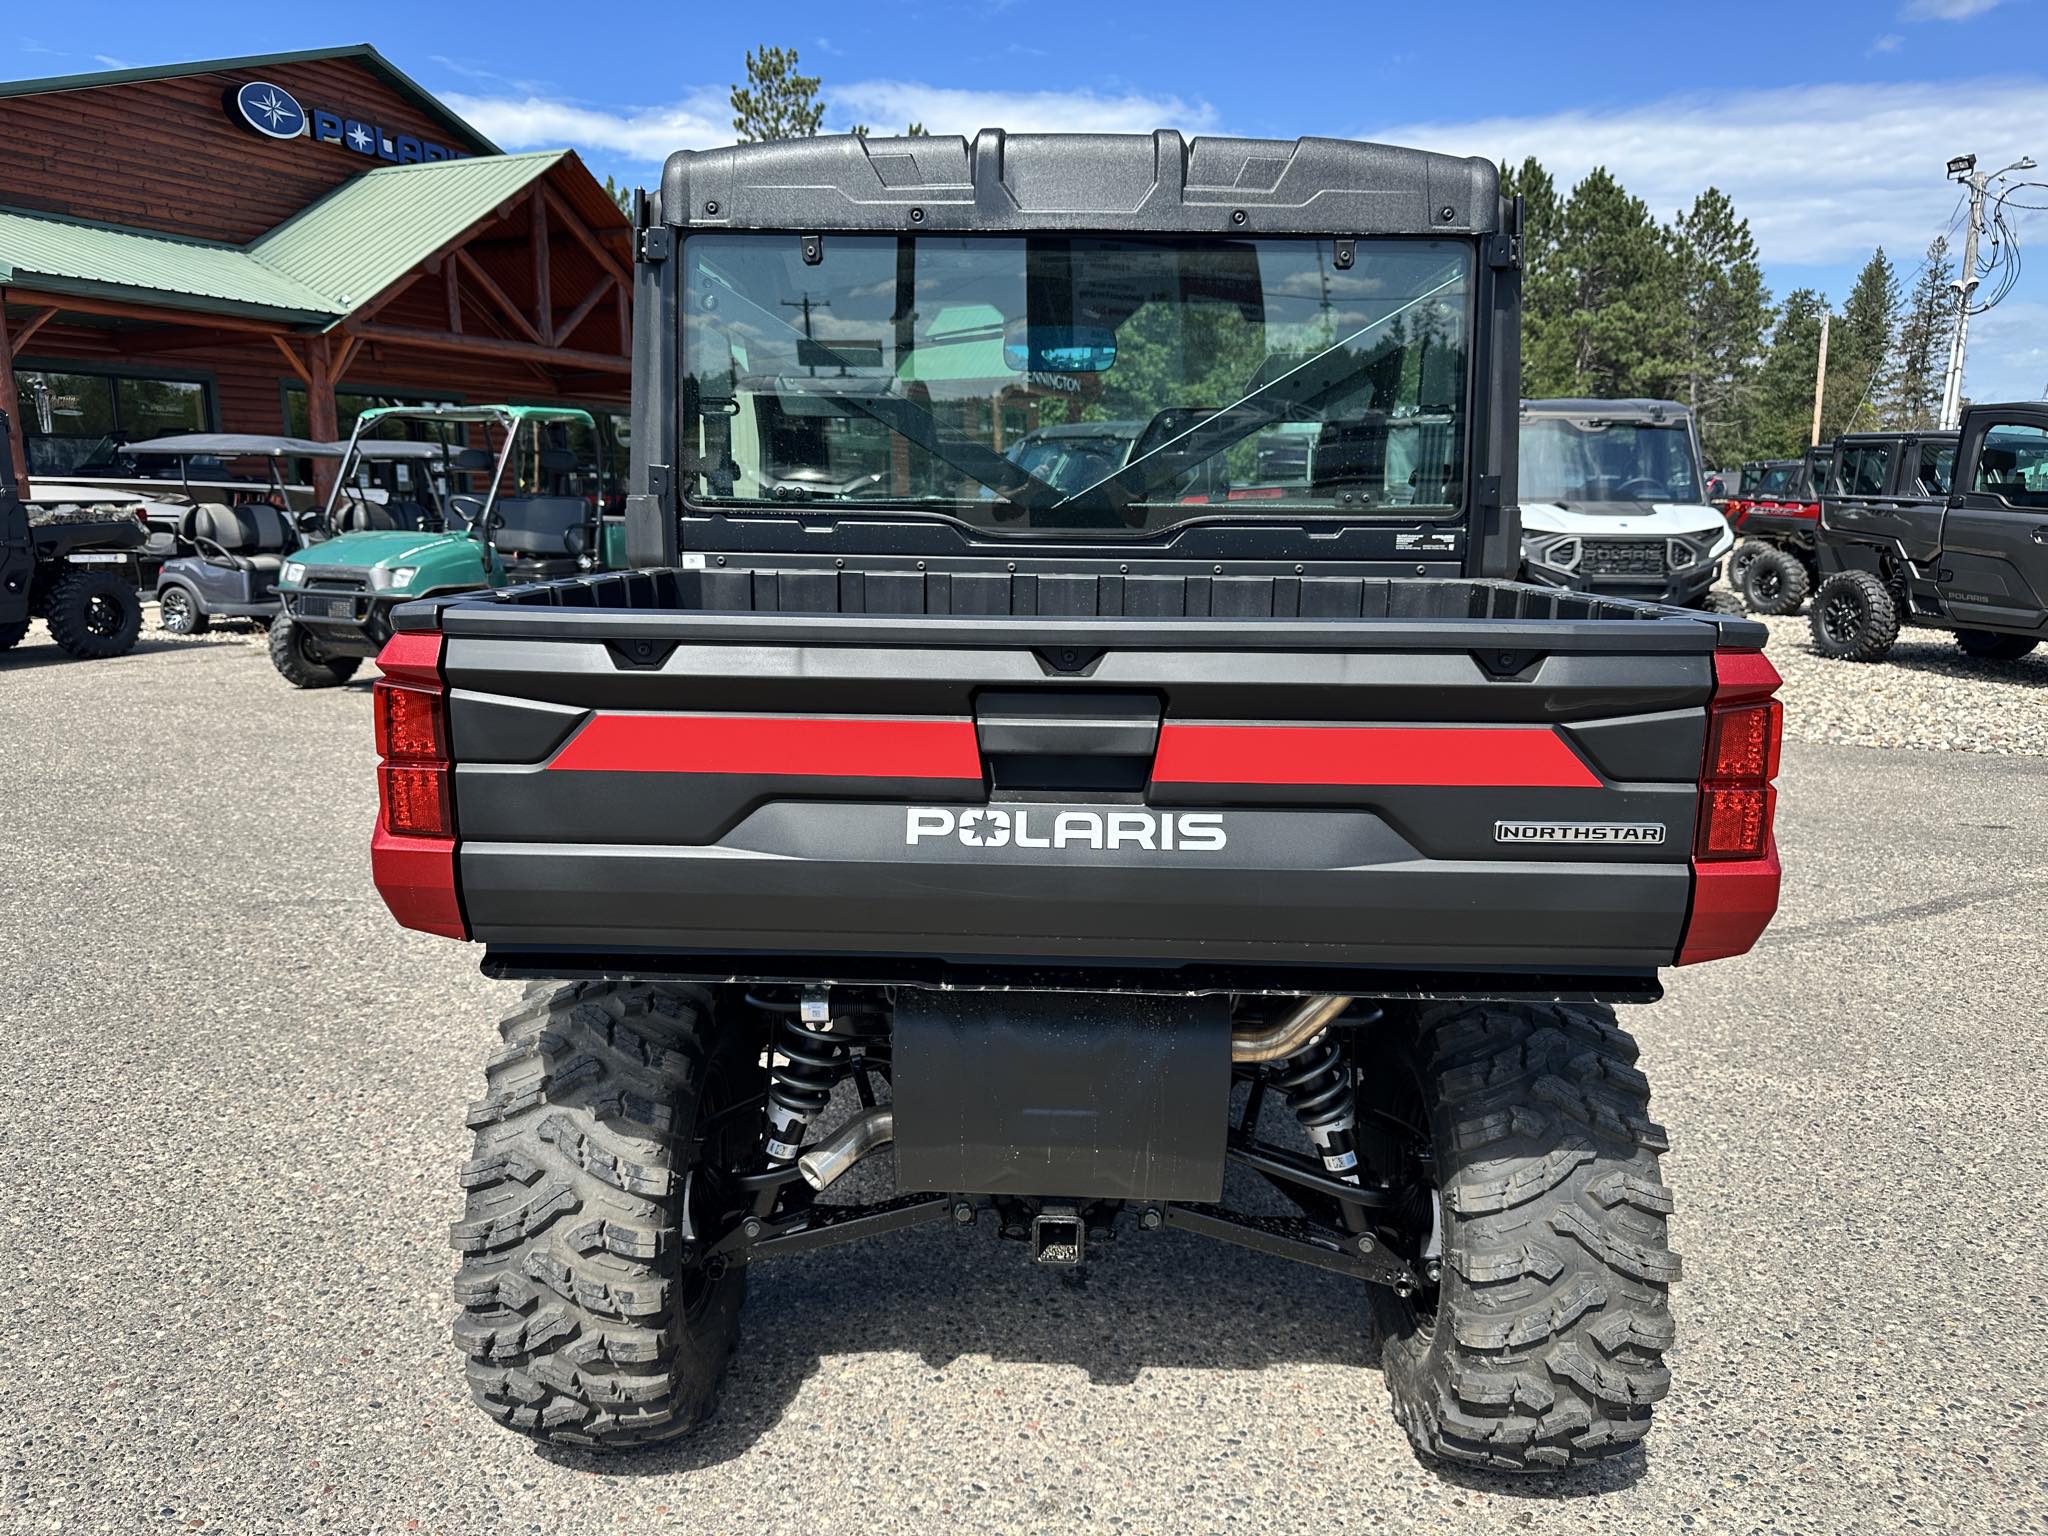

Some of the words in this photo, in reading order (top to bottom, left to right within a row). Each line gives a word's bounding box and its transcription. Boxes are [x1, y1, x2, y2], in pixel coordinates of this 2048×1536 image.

[313, 108, 472, 165] POLAR
[1584, 549, 1661, 560] POLARIS
[1948, 592, 1989, 603] POLARIS
[905, 808, 1228, 851] POLARIS
[1502, 826, 1659, 840] NORTHSTAR
